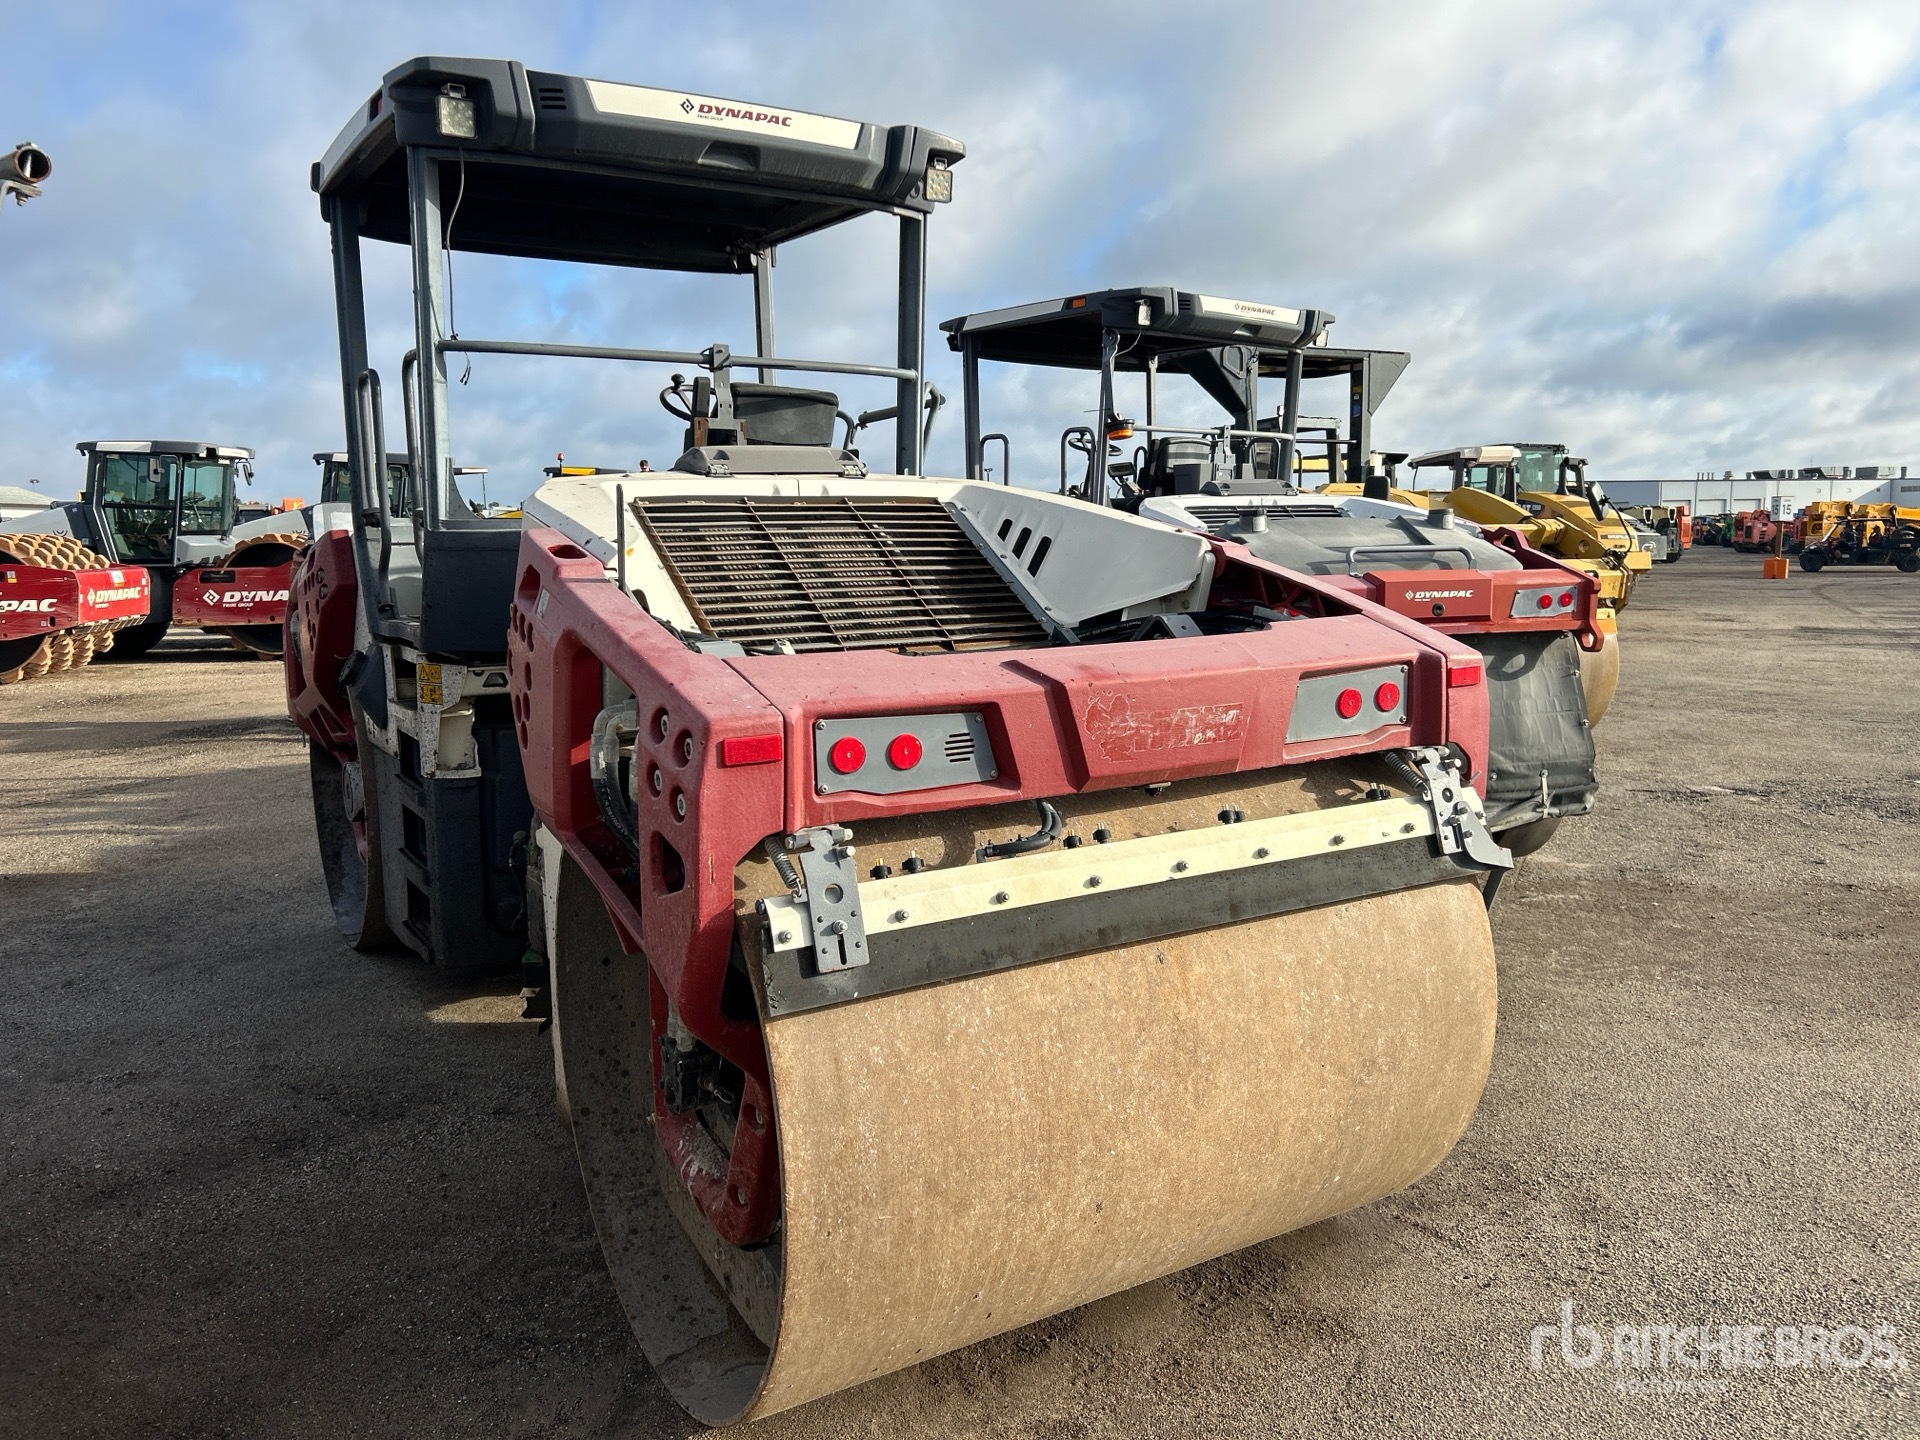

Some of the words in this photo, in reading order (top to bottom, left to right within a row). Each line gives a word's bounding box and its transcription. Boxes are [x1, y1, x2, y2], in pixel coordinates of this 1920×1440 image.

[698, 104, 792, 127] DYNAPAC
[1241, 305, 1275, 315] DYNAPAC
[1772, 504, 1779, 515] 15
[1782, 504, 1792, 515] 15
[95, 586, 141, 603] DYNAPAC
[222, 590, 290, 603] DYNA
[1415, 590, 1473, 598] DYNAPAC
[0, 598, 58, 612] PAC
